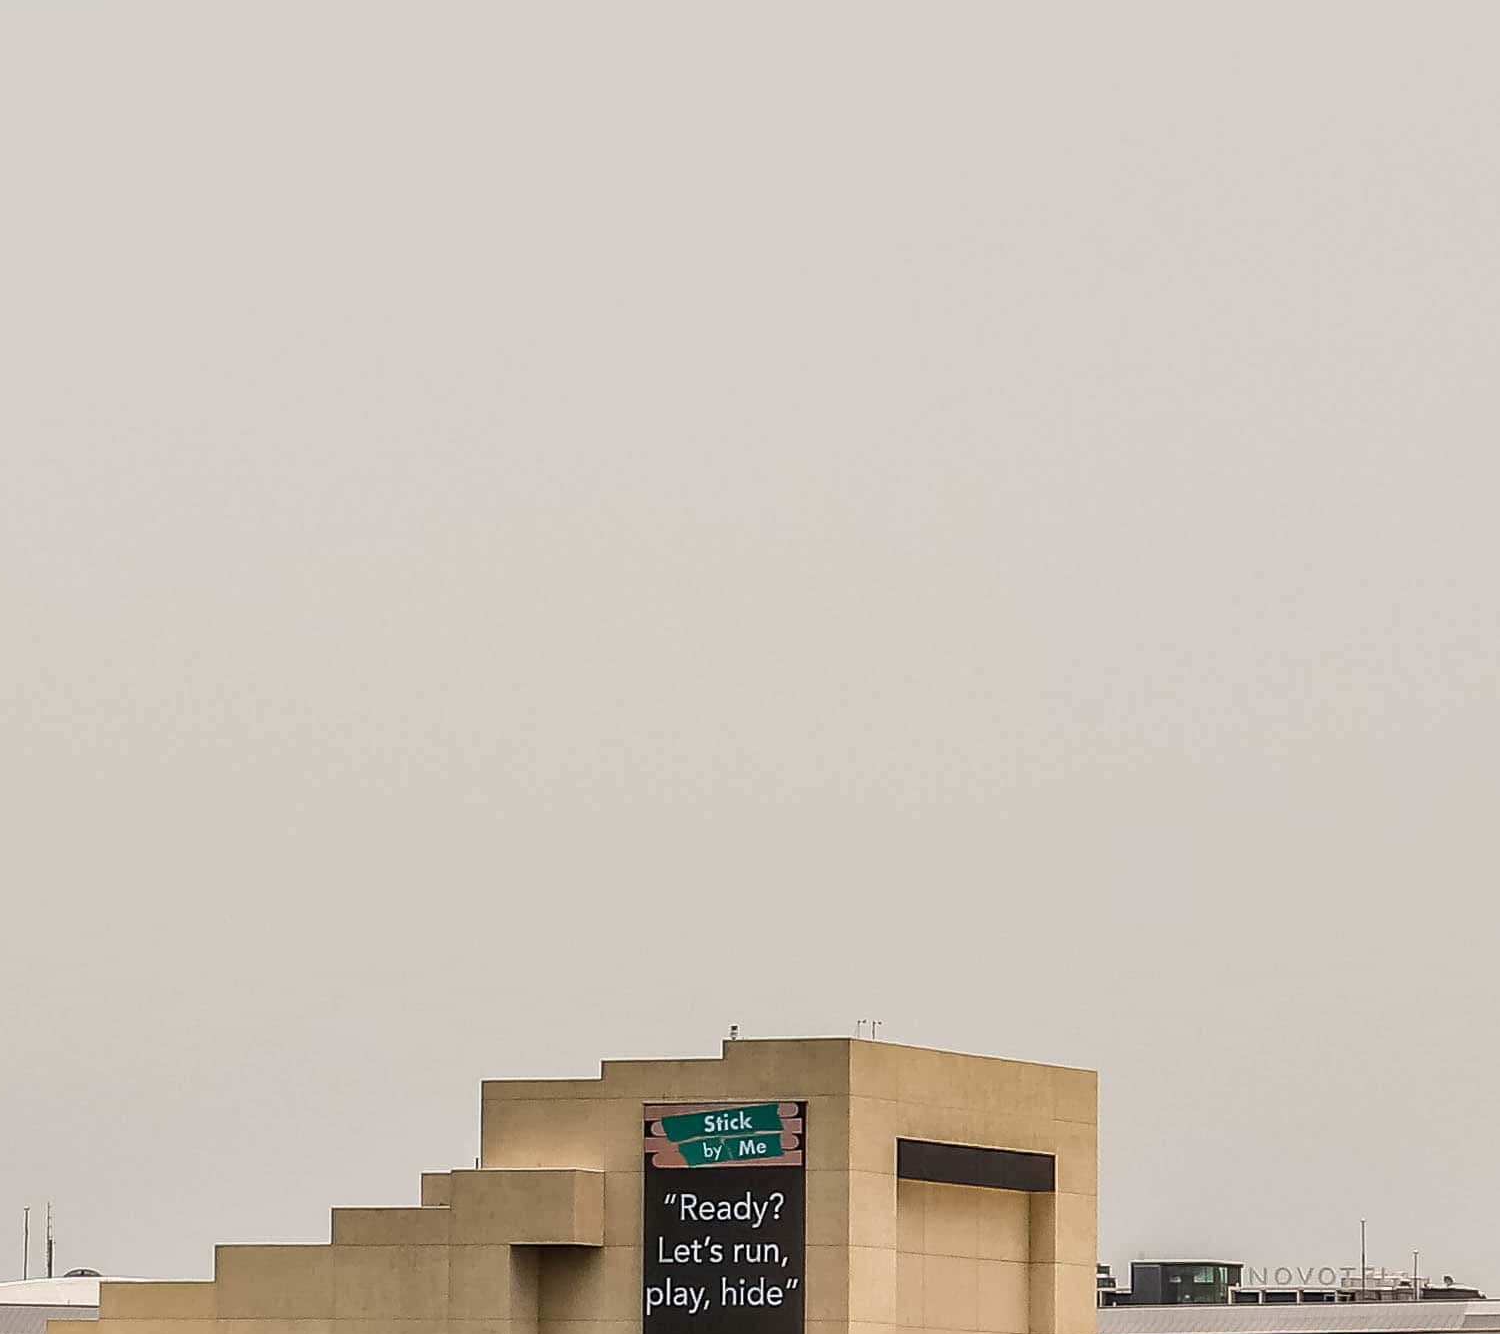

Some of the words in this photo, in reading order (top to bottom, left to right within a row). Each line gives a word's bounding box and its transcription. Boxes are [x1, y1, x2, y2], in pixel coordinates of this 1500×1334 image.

[703, 1112, 753, 1134] Stick
[702, 1140, 723, 1161] by
[737, 1138, 768, 1157] Me
[733, 1243, 789, 1267] run,
[646, 1277, 710, 1315] play,
